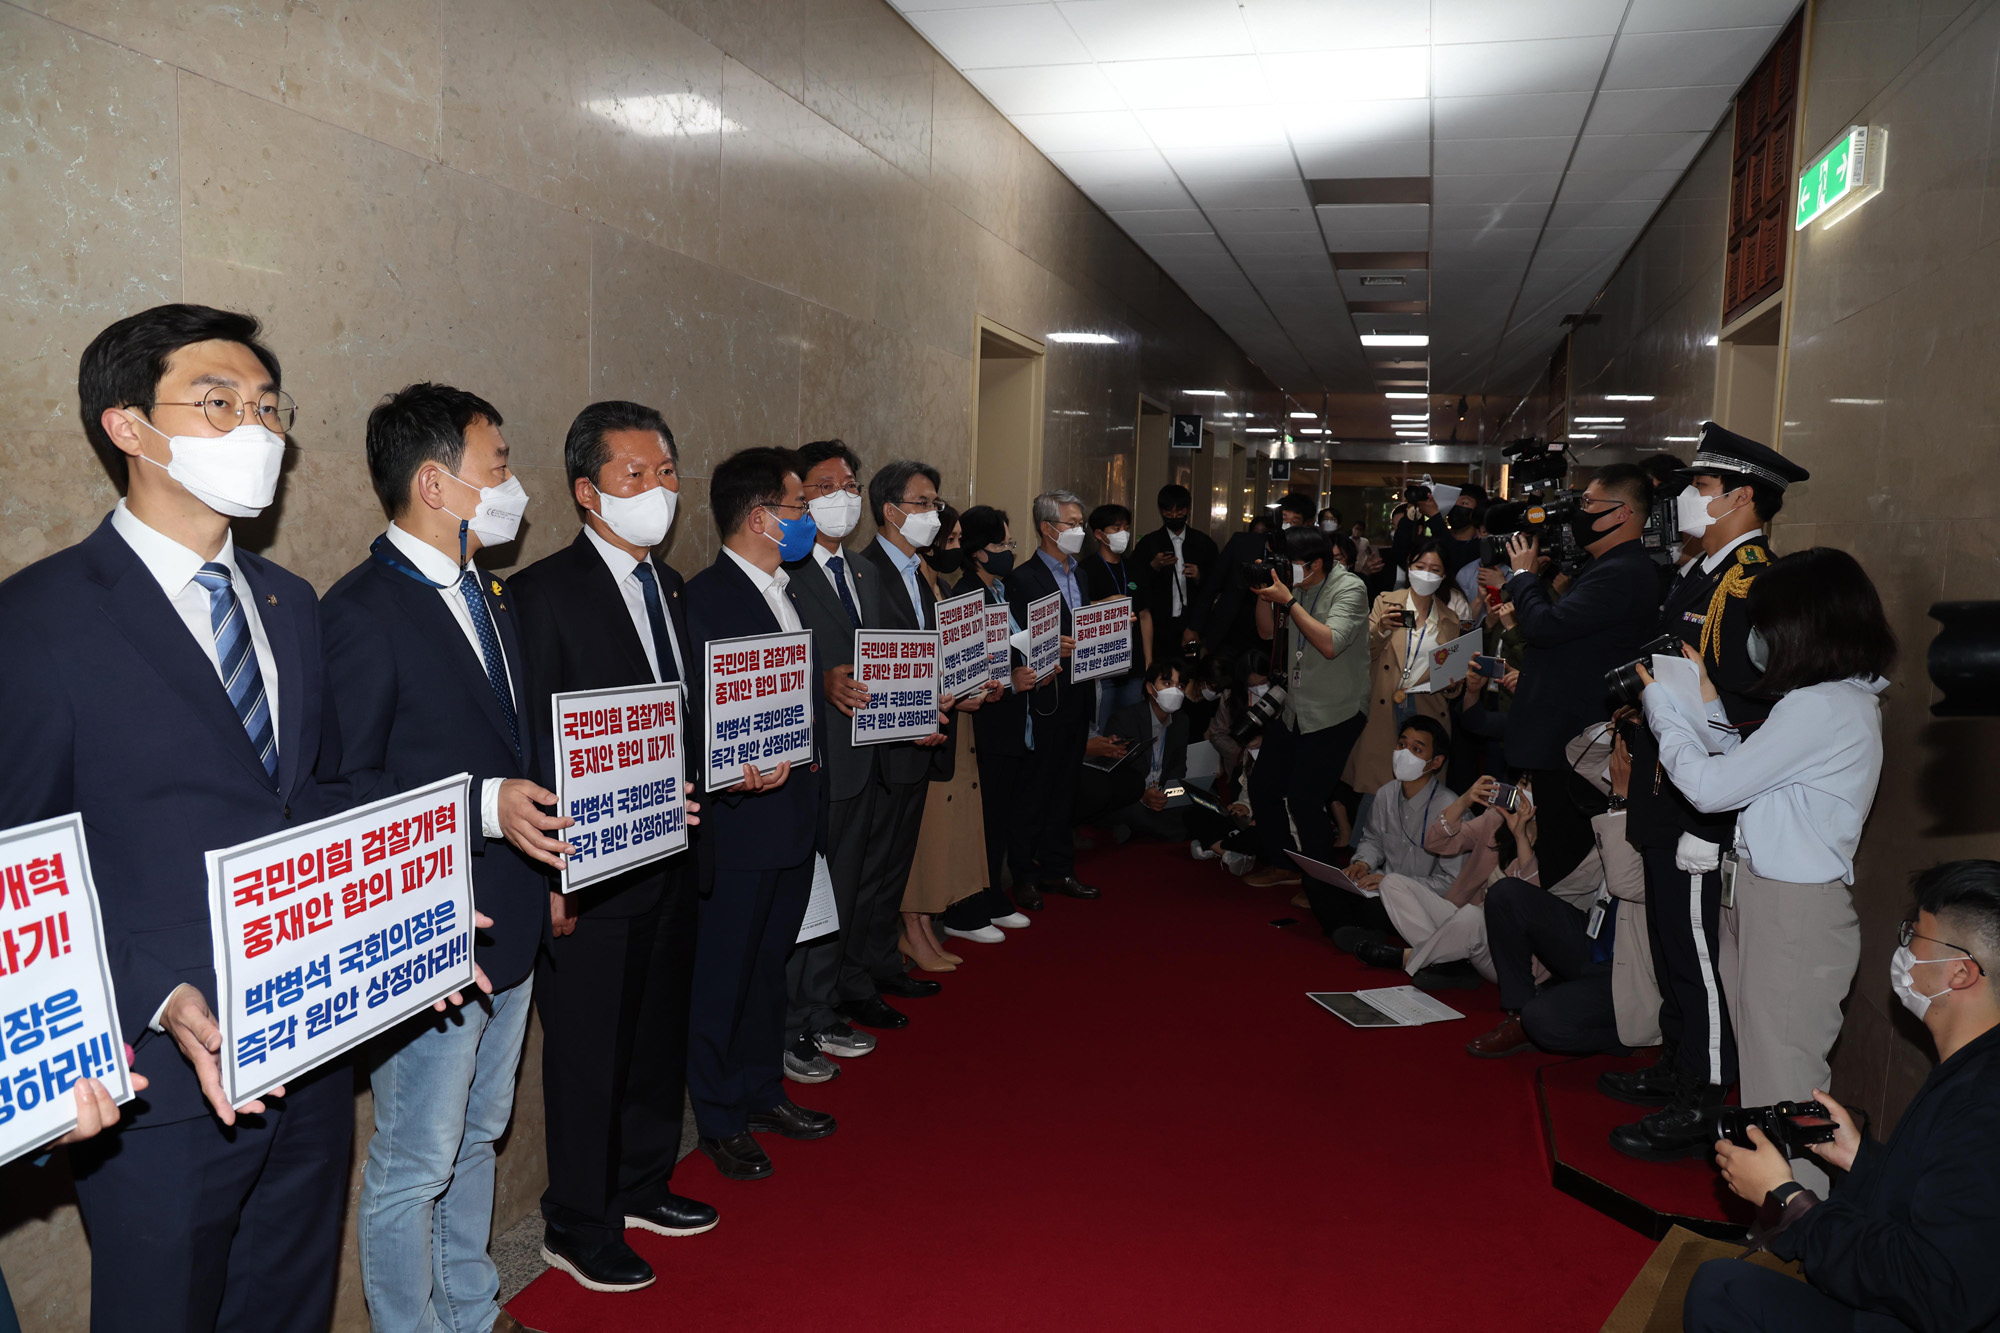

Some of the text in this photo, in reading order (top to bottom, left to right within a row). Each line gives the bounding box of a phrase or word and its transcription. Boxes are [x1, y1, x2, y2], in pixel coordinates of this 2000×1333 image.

[1076, 605, 1128, 626] 국민의힘 검찰개혁
[1078, 620, 1127, 641] 중재안 합의 파기!
[714, 644, 806, 676] 국민의힘 검찰개혁
[861, 642, 935, 659] 국민의힘 검찰개혁
[1075, 651, 1130, 674] 즉각 원안 상정하라!!
[1077, 638, 1127, 659] 박병석 국회의장은
[716, 670, 804, 705] 중재안 합의 파기!
[863, 663, 933, 680] 중재안 합의 파기!
[866, 690, 932, 709] 병석 국회의장은
[564, 701, 676, 740] 국민의힘 검찰개혁
[717, 704, 804, 741] 박병석 국회의장은
[858, 710, 936, 730] 즉각 원안 상정하라!!
[570, 734, 675, 778] 중재안 합의 파기!
[712, 728, 809, 769] 즉각 원안 상정하라!!
[571, 777, 675, 826] 박병석 국회의장은
[568, 806, 683, 863] 즉각 원안 상정하라!!
[233, 802, 456, 907] 국민의힘 검찰개혁
[243, 845, 453, 959] 중재안 합의 파기!
[246, 900, 456, 1016] 박병석 국회의장은
[238, 932, 467, 1068] 즉각 원안 상정하라!!
[0, 988, 84, 1062] 장은
